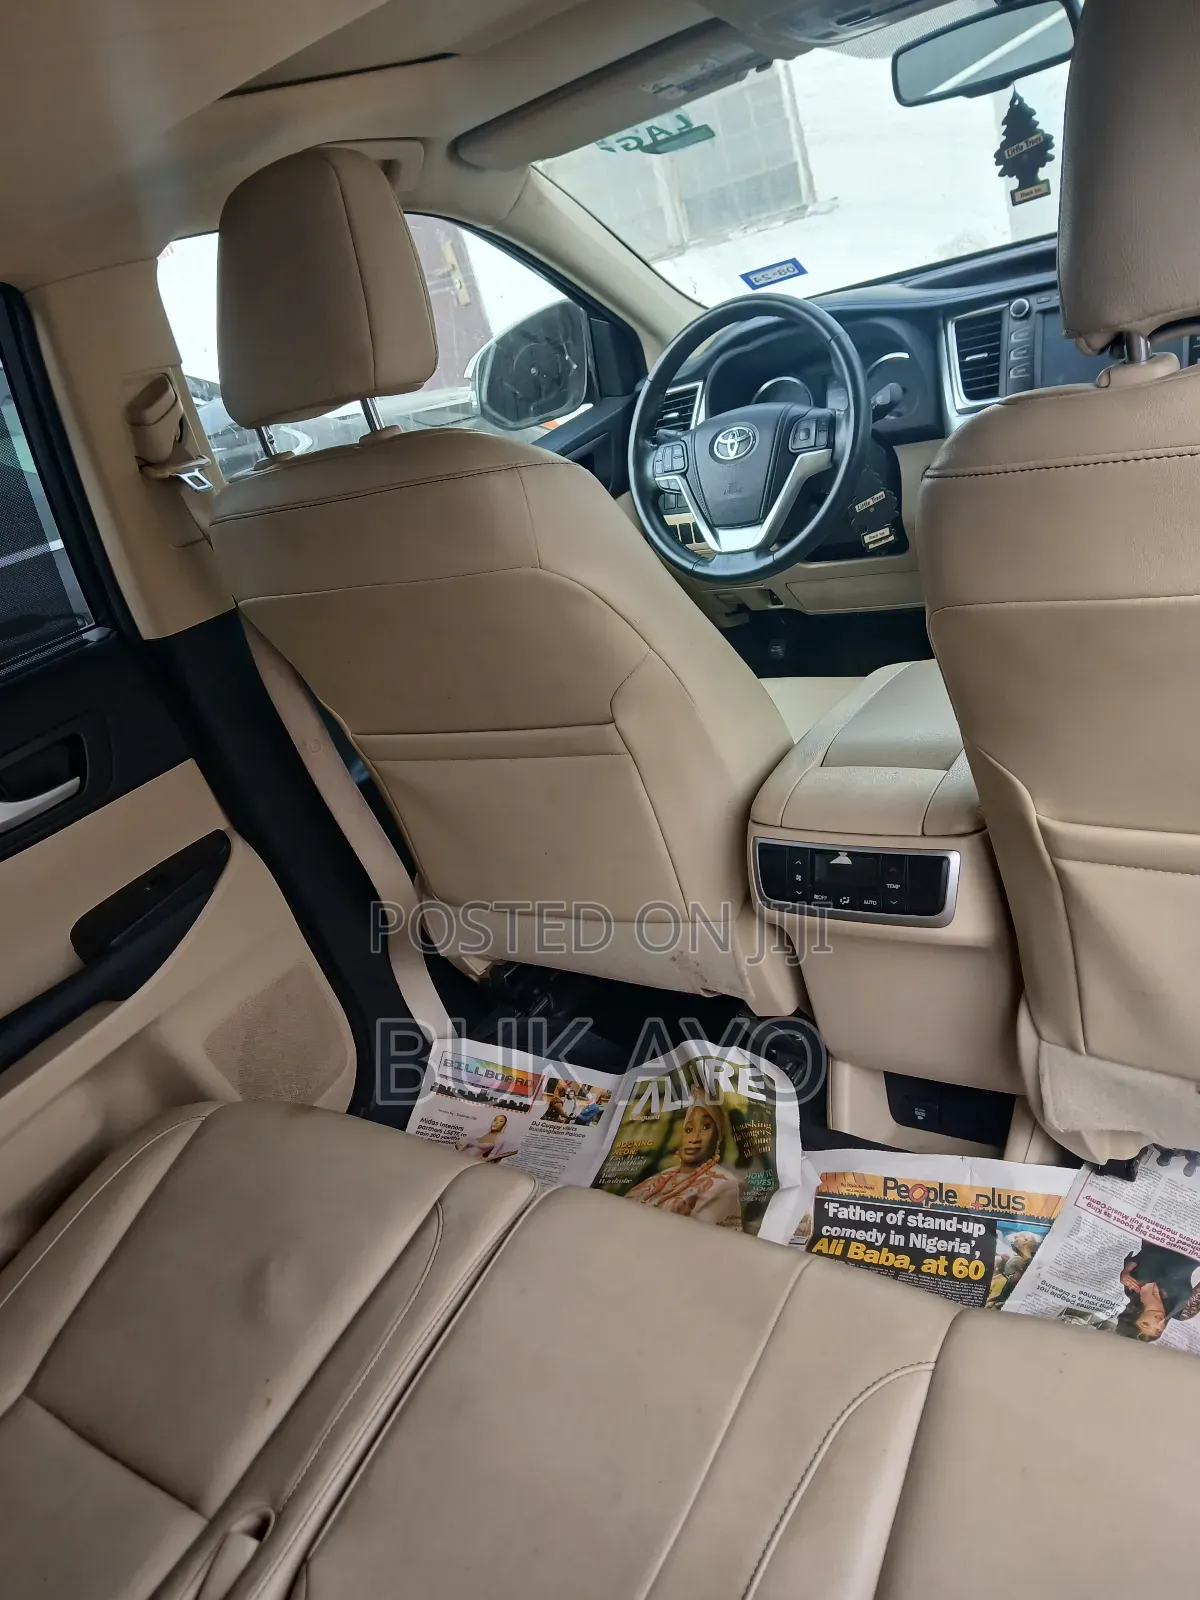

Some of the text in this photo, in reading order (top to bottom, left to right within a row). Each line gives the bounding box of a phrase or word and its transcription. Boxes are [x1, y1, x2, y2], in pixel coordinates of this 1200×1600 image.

[1006, 136, 1042, 157] Little Trees
[857, 493, 884, 511] Little Trees
[443, 1058, 537, 1088] BILLBOARD
[417, 1124, 443, 1135] partners
[420, 1117, 465, 1132] Midas Interiors
[528, 1125, 586, 1139] Buckingham Palace
[541, 1122, 562, 1131] Cuppy
[415, 1130, 430, 1138] train
[616, 1140, 654, 1149] ROCKING
[744, 1171, 765, 1181] HOW
[883, 1176, 1025, 1211] People plus
[1085, 1201, 1103, 1216] King
[1103, 1210, 1113, 1221] as
[1106, 1204, 1130, 1221] Music
[824, 1201, 986, 1238] ‘Father of stand-up
[1112, 1215, 1135, 1231] boost
[1135, 1212, 1179, 1237] momentum
[1135, 1223, 1148, 1238] big
[821, 1225, 981, 1260] comedy in Nigeria’,
[1148, 1232, 1166, 1246] gets
[1165, 1240, 1188, 1253] music
[1175, 1238, 1200, 1253] aheed
[811, 1237, 846, 1257] Ali
[846, 1241, 916, 1274] Baba,
[920, 1255, 949, 1277] at
[952, 1257, 986, 1281] 60
[1036, 1284, 1050, 1294] not
[1040, 1279, 1071, 1298] blessing
[1049, 1290, 1077, 1306] people
